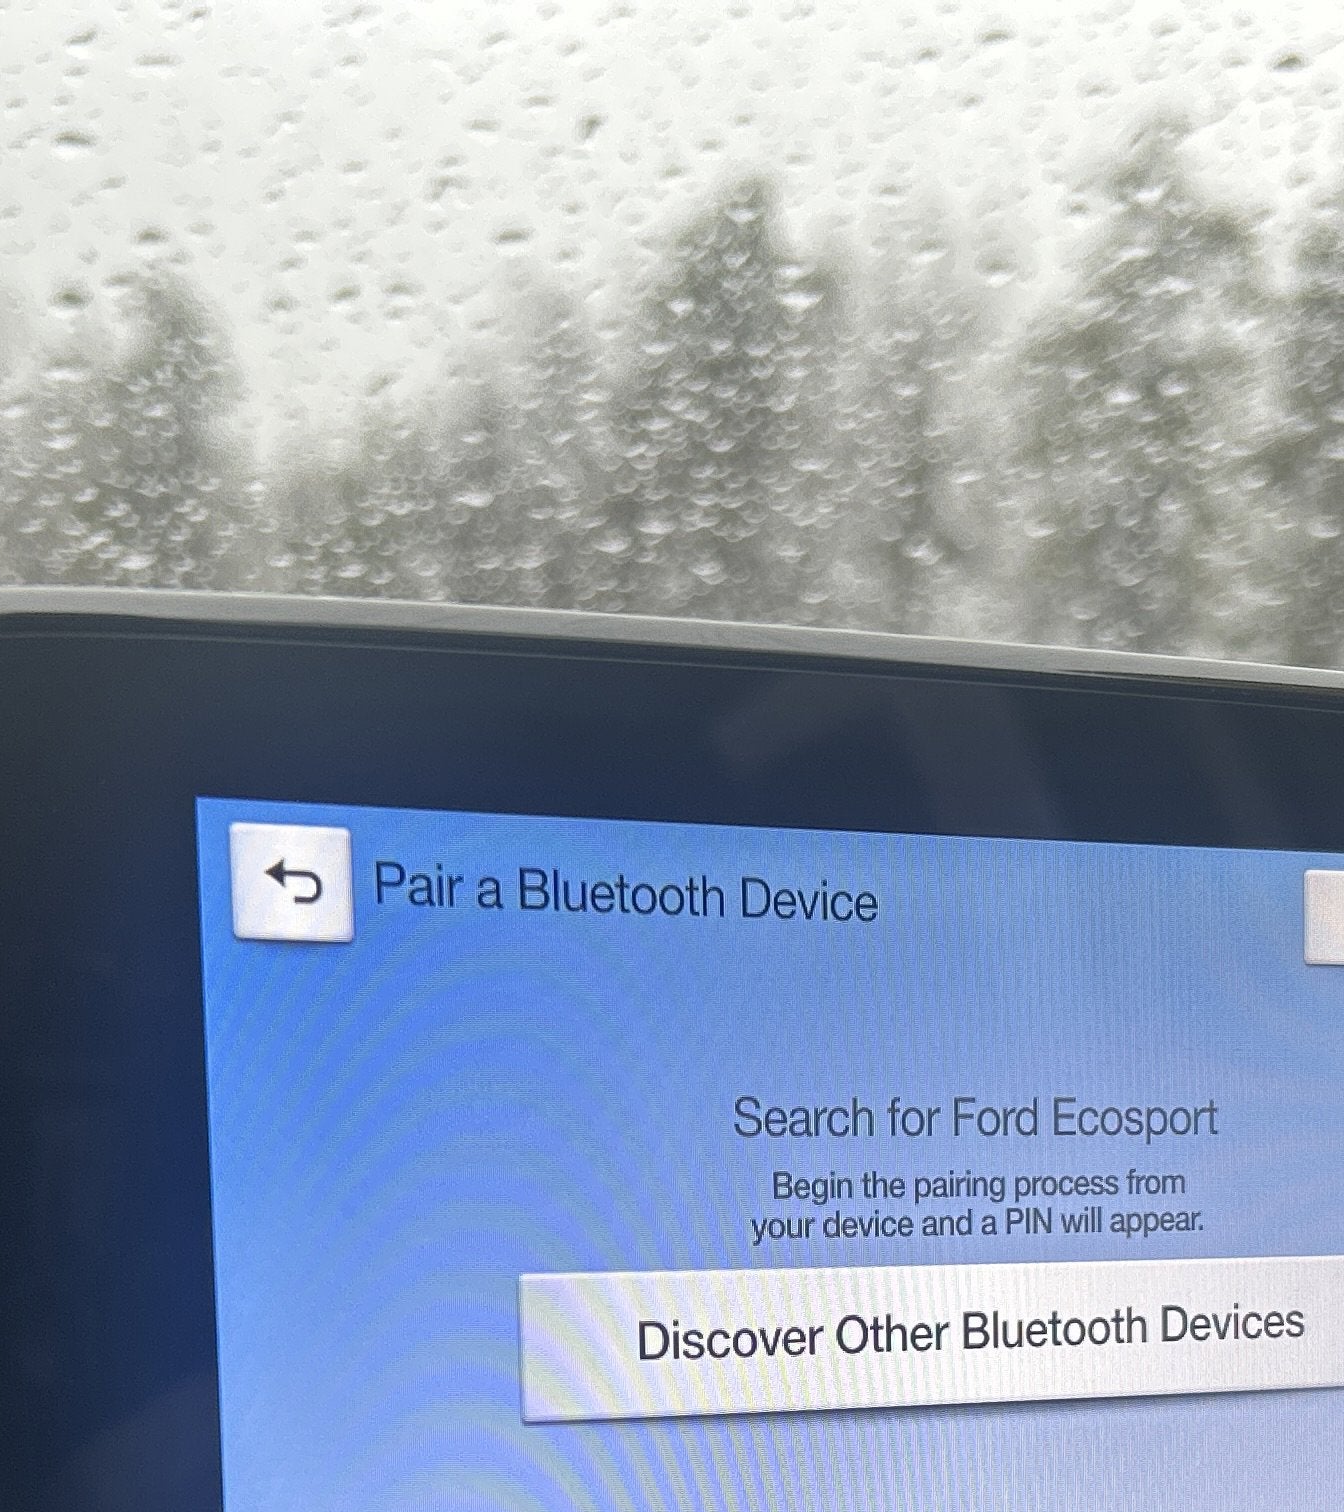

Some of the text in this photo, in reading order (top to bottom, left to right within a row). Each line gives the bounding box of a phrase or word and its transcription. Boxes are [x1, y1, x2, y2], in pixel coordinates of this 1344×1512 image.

[374, 861, 879, 922] Pair a Bluetooth Device
[734, 1096, 1219, 1144] Search for Ford Ecosport
[772, 1168, 1186, 1205] Begin the pairing process from
[751, 1206, 1205, 1246] your device and a PIN will appear.
[637, 1303, 1306, 1361] Discover Other Bluetooth Devices
